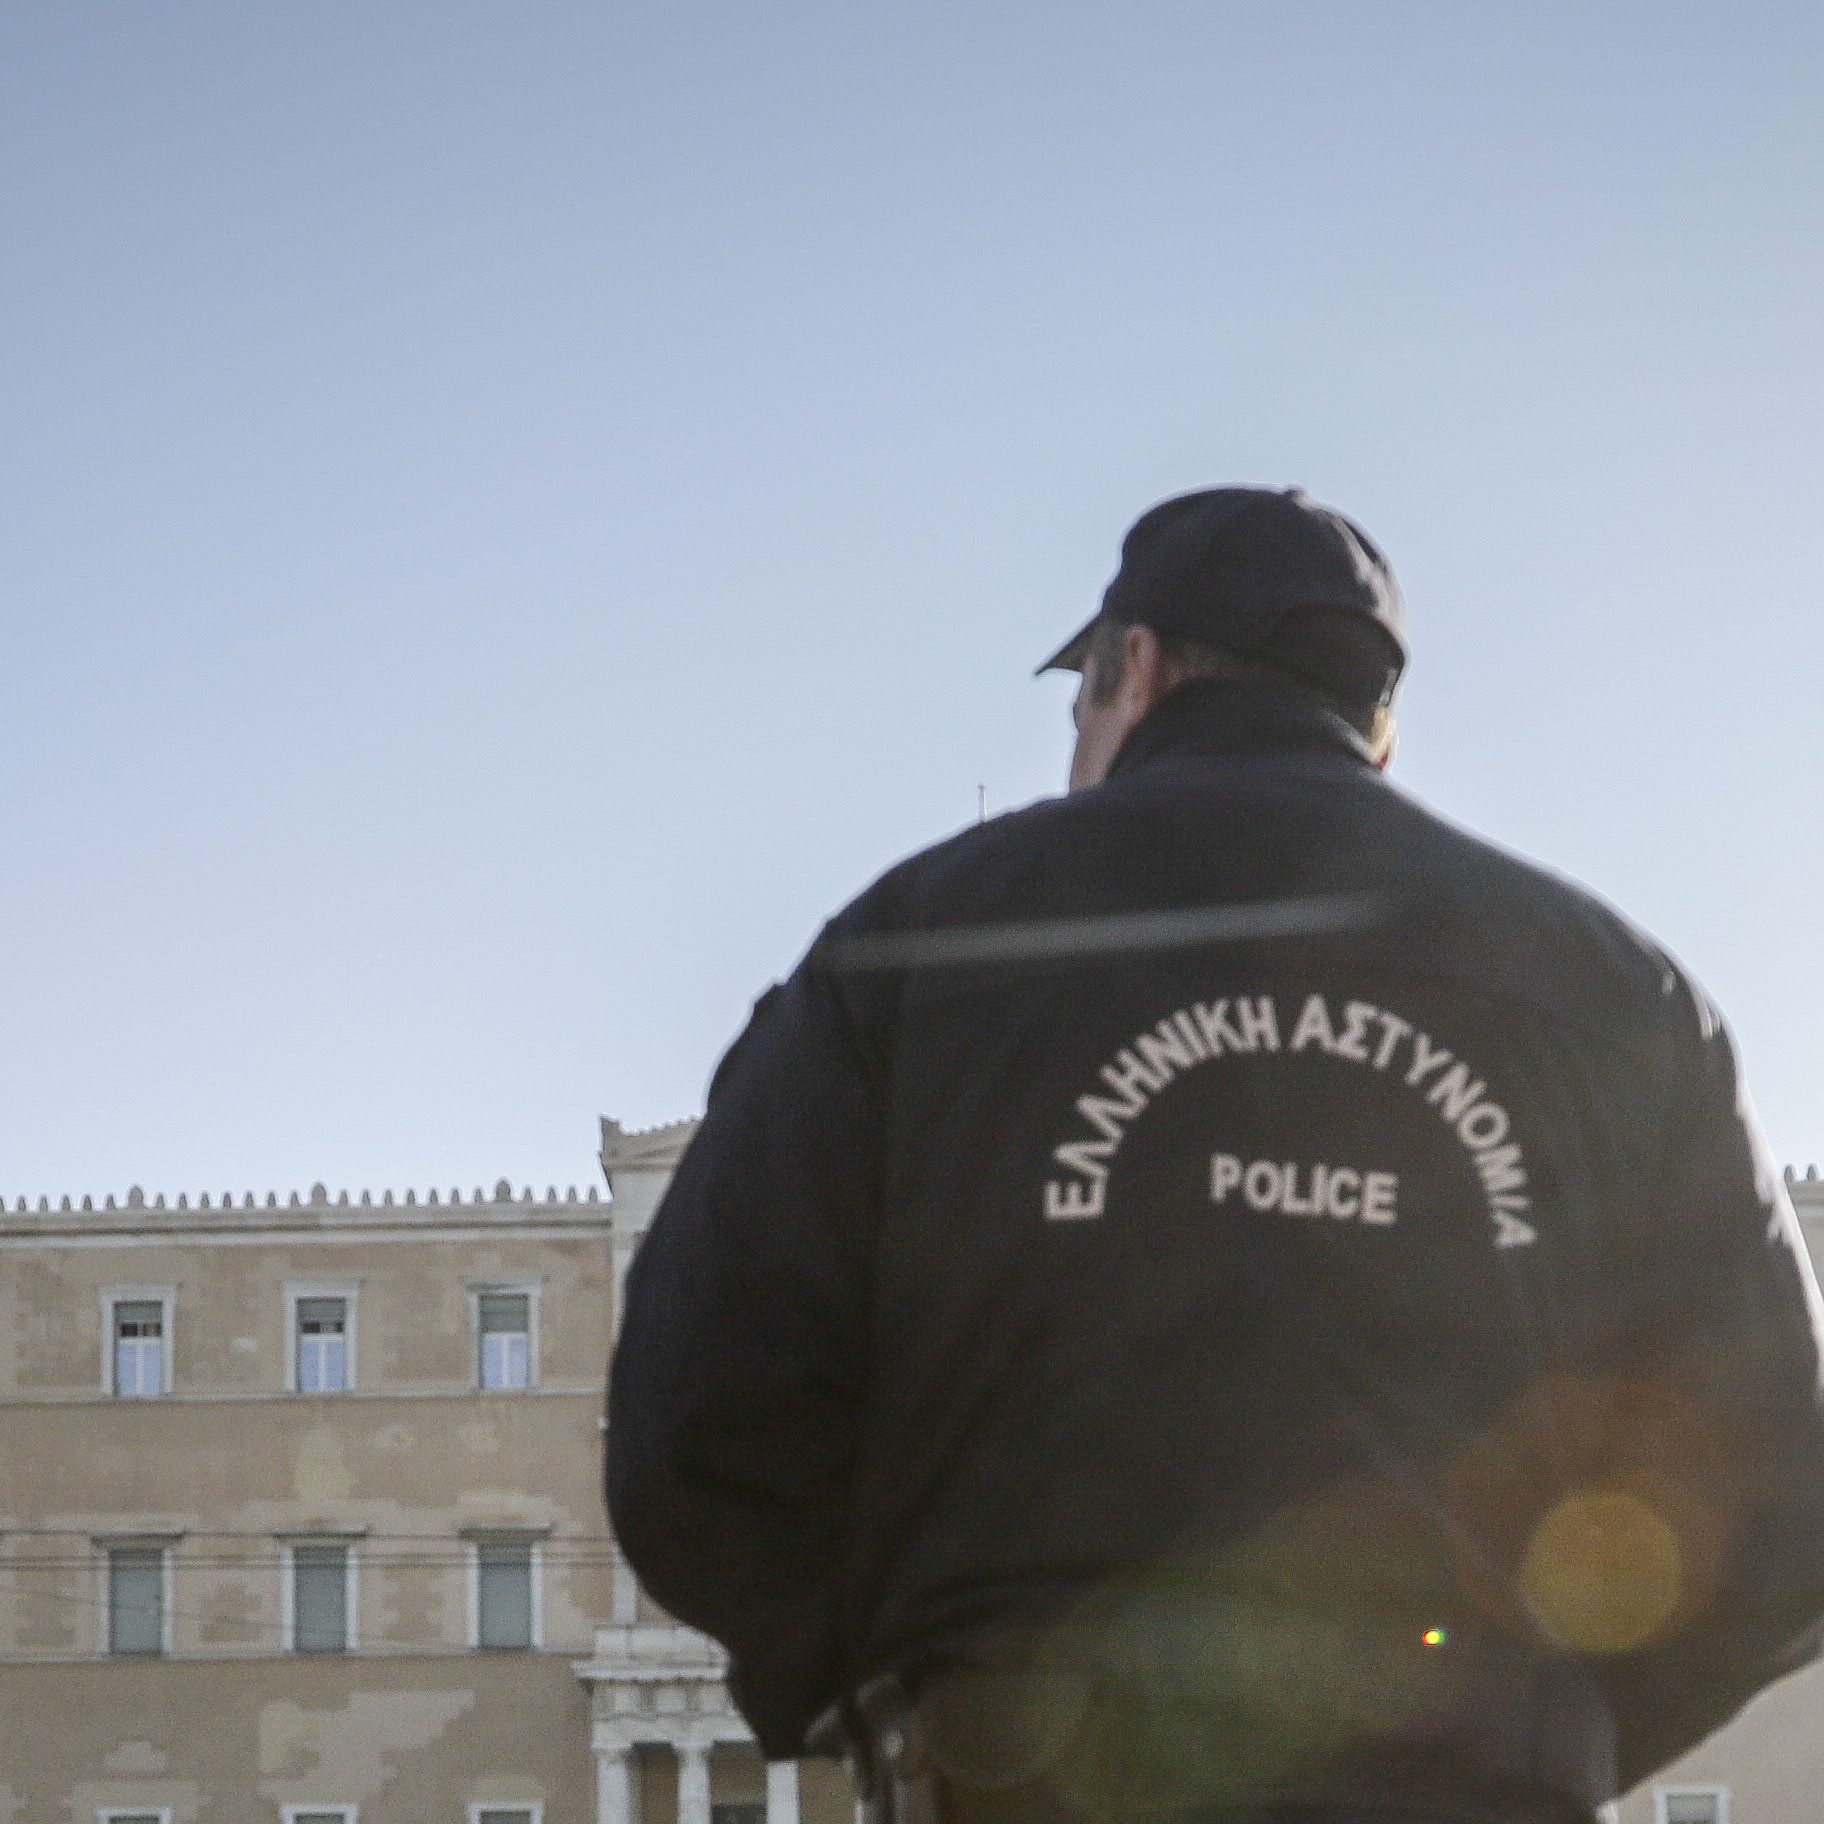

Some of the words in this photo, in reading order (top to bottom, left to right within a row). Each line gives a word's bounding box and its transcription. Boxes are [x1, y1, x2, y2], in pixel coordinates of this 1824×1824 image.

[1043, 995, 1280, 1222] ΕΛΛΗΝΙΚΗ
[1290, 993, 1538, 1250] ΑΣΤΥΝΟΜΙΑ
[1208, 1153, 1399, 1226] POLICE
